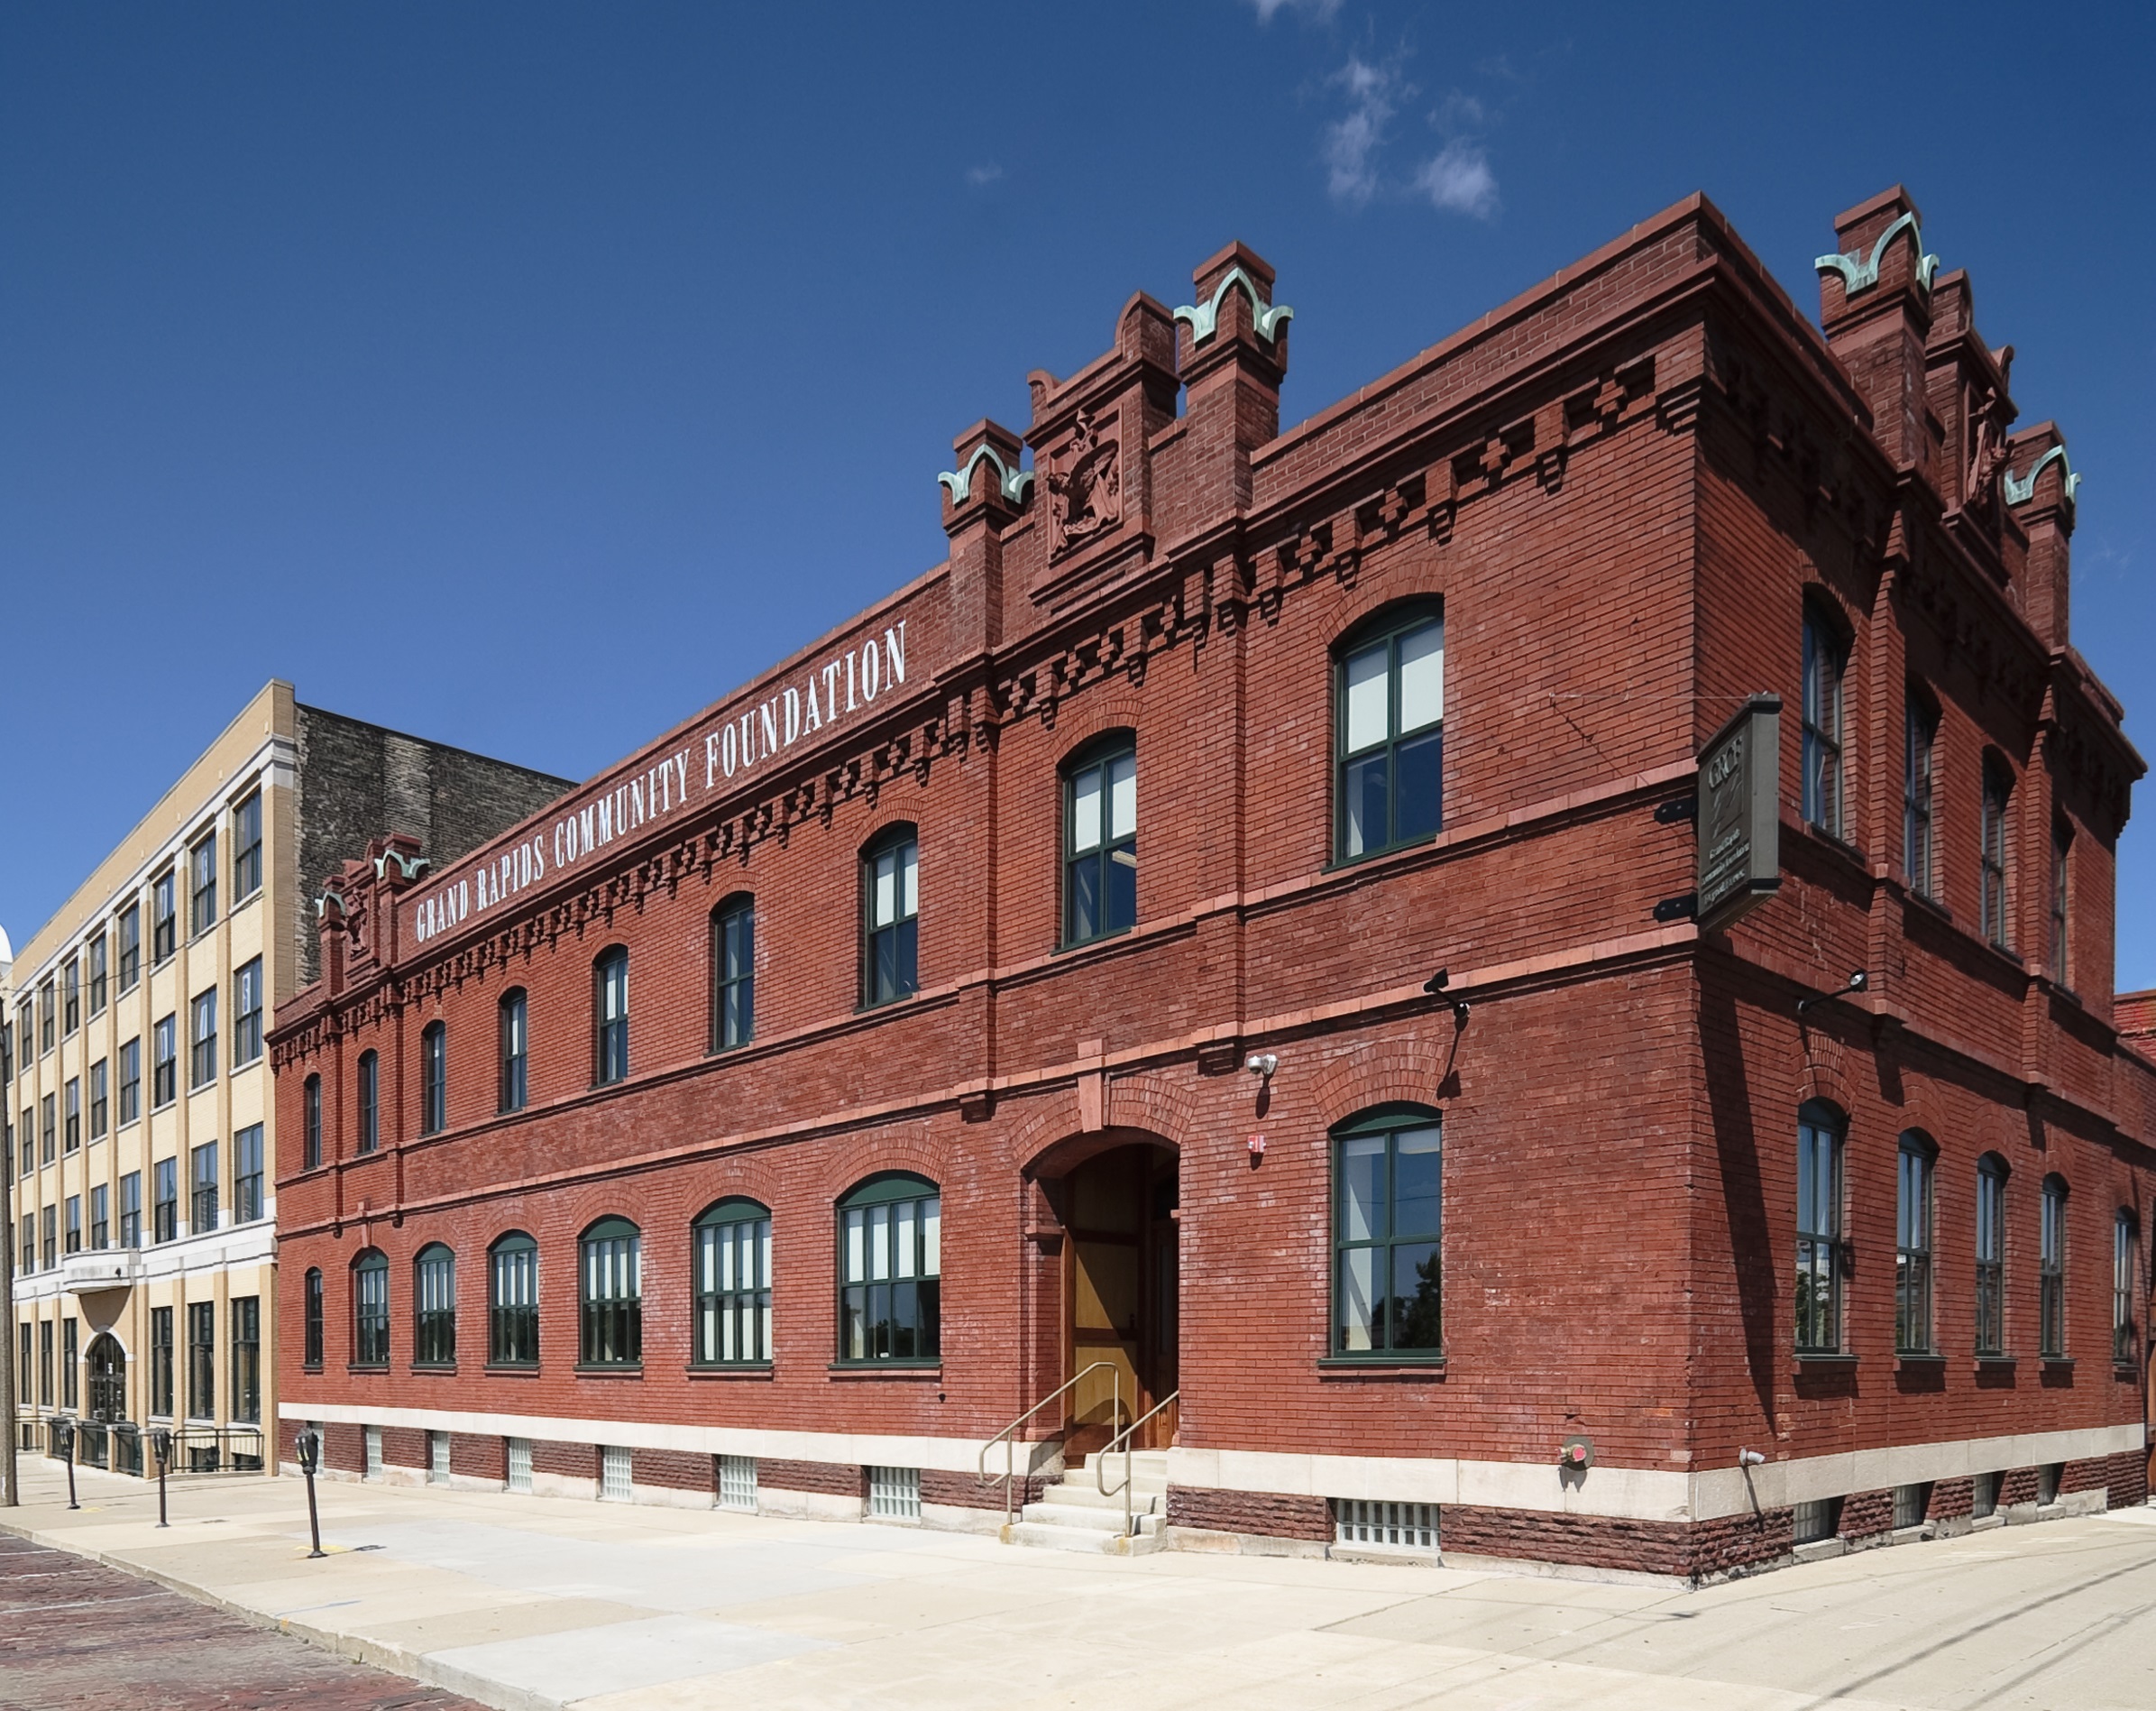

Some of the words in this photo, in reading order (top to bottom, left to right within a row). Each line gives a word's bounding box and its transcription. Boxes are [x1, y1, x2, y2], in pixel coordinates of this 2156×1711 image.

[417, 879, 468, 943] GRAND
[477, 834, 545, 912] RAPIDS
[554, 747, 691, 869] COMMUNITY
[705, 620, 907, 790] FOUNDATION
